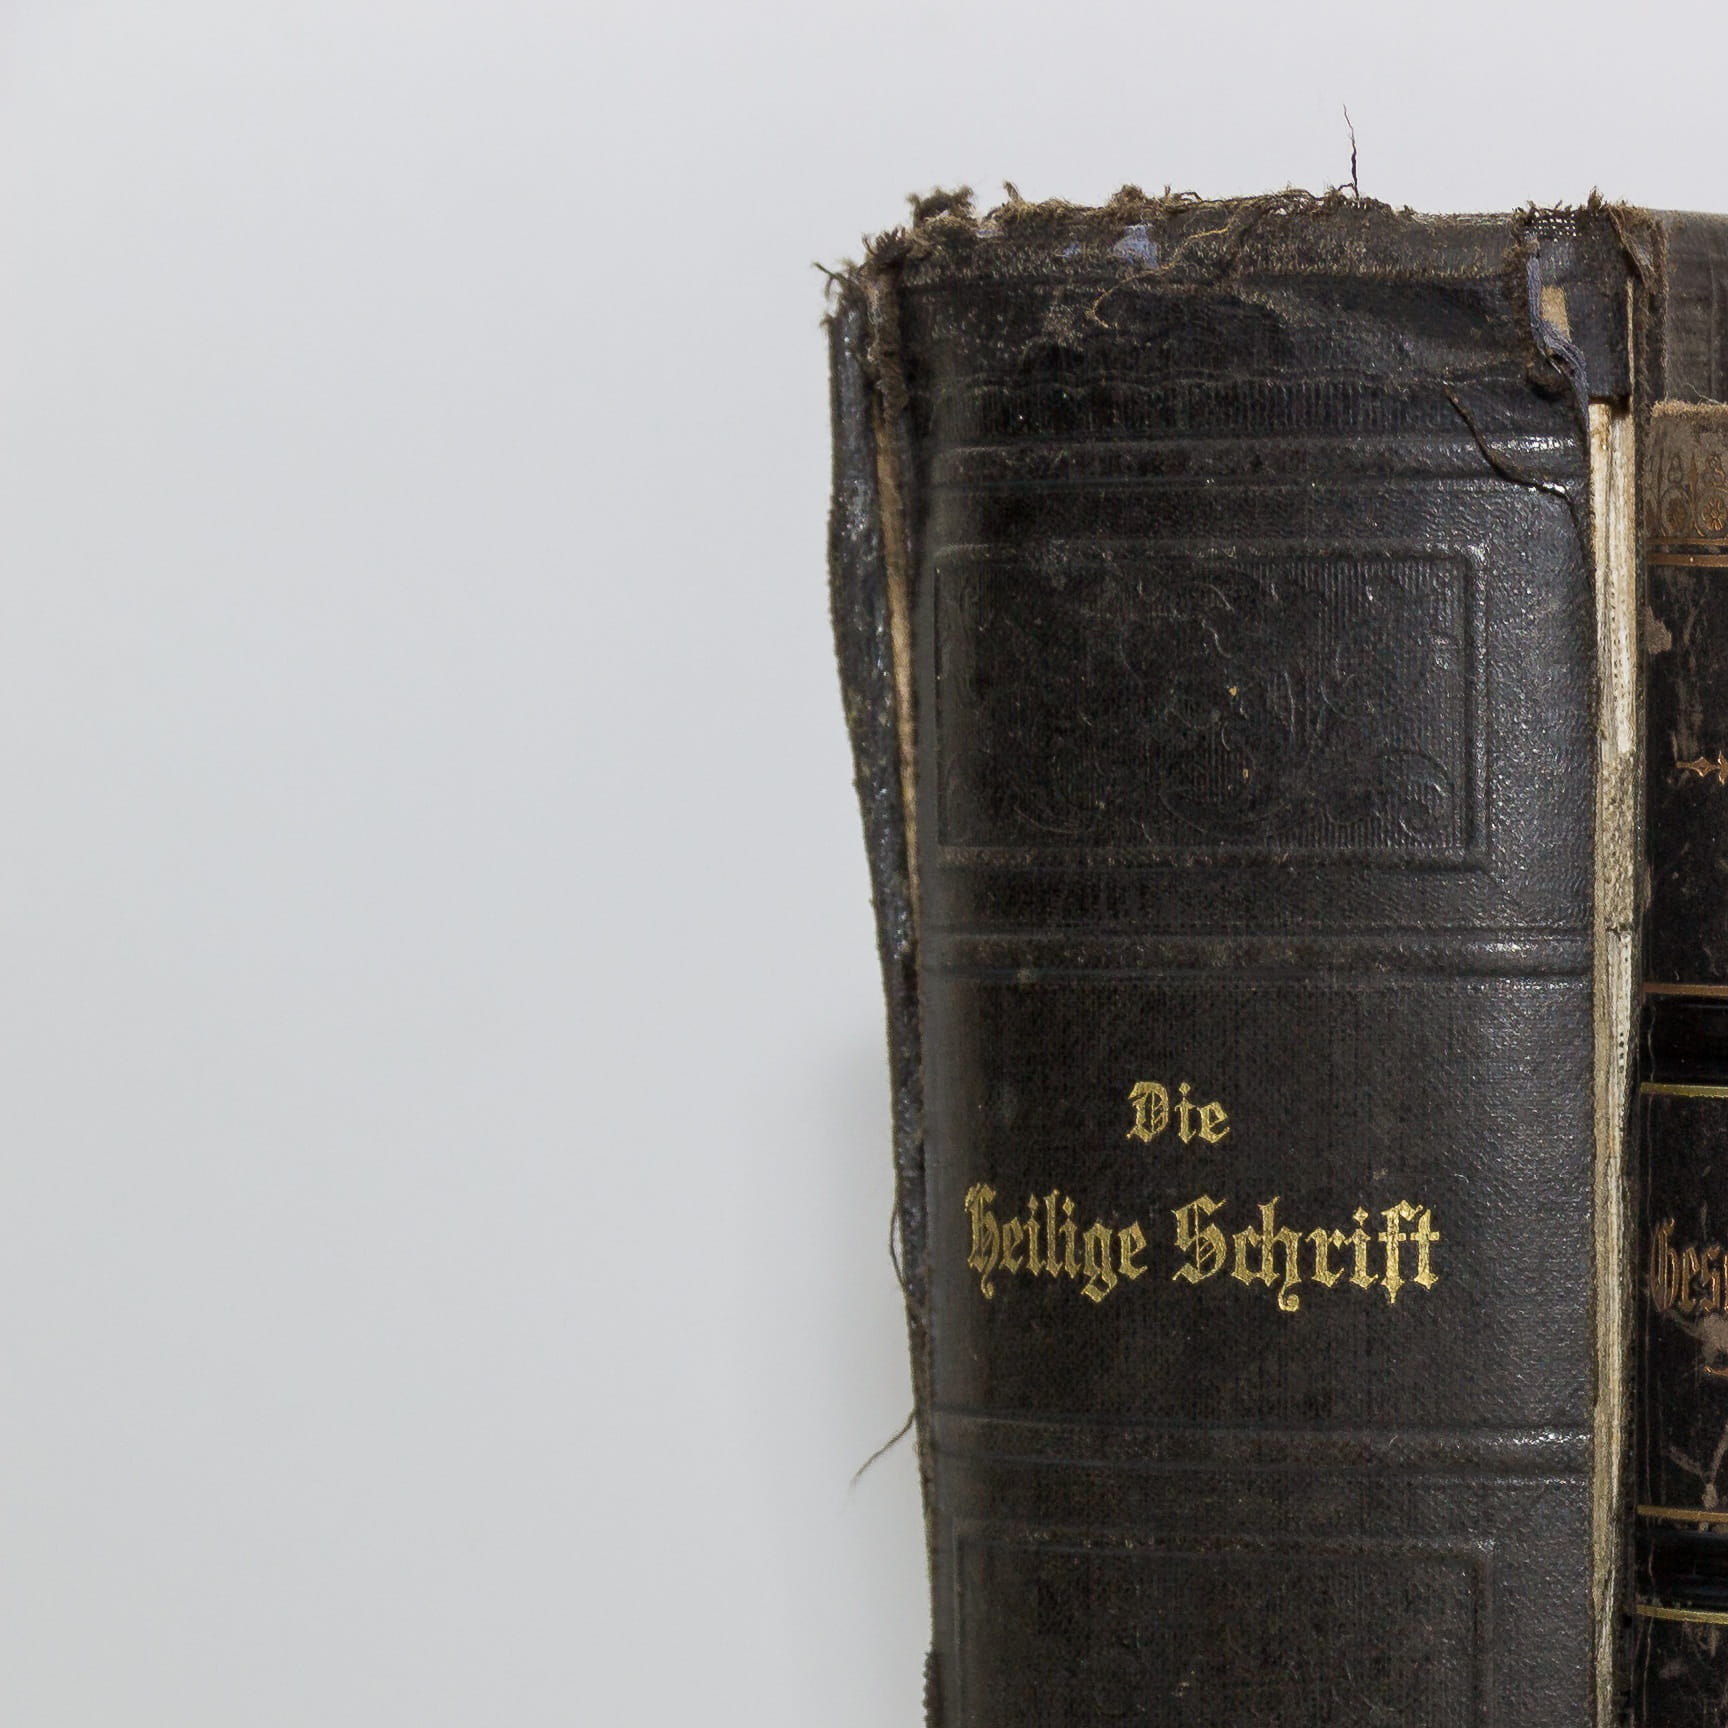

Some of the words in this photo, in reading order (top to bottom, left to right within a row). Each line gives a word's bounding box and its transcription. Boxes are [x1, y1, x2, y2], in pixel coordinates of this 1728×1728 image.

[1125, 1080, 1231, 1145] Die
[963, 1182, 1149, 1304] Heilige
[1171, 1193, 1441, 1313] Schrift
